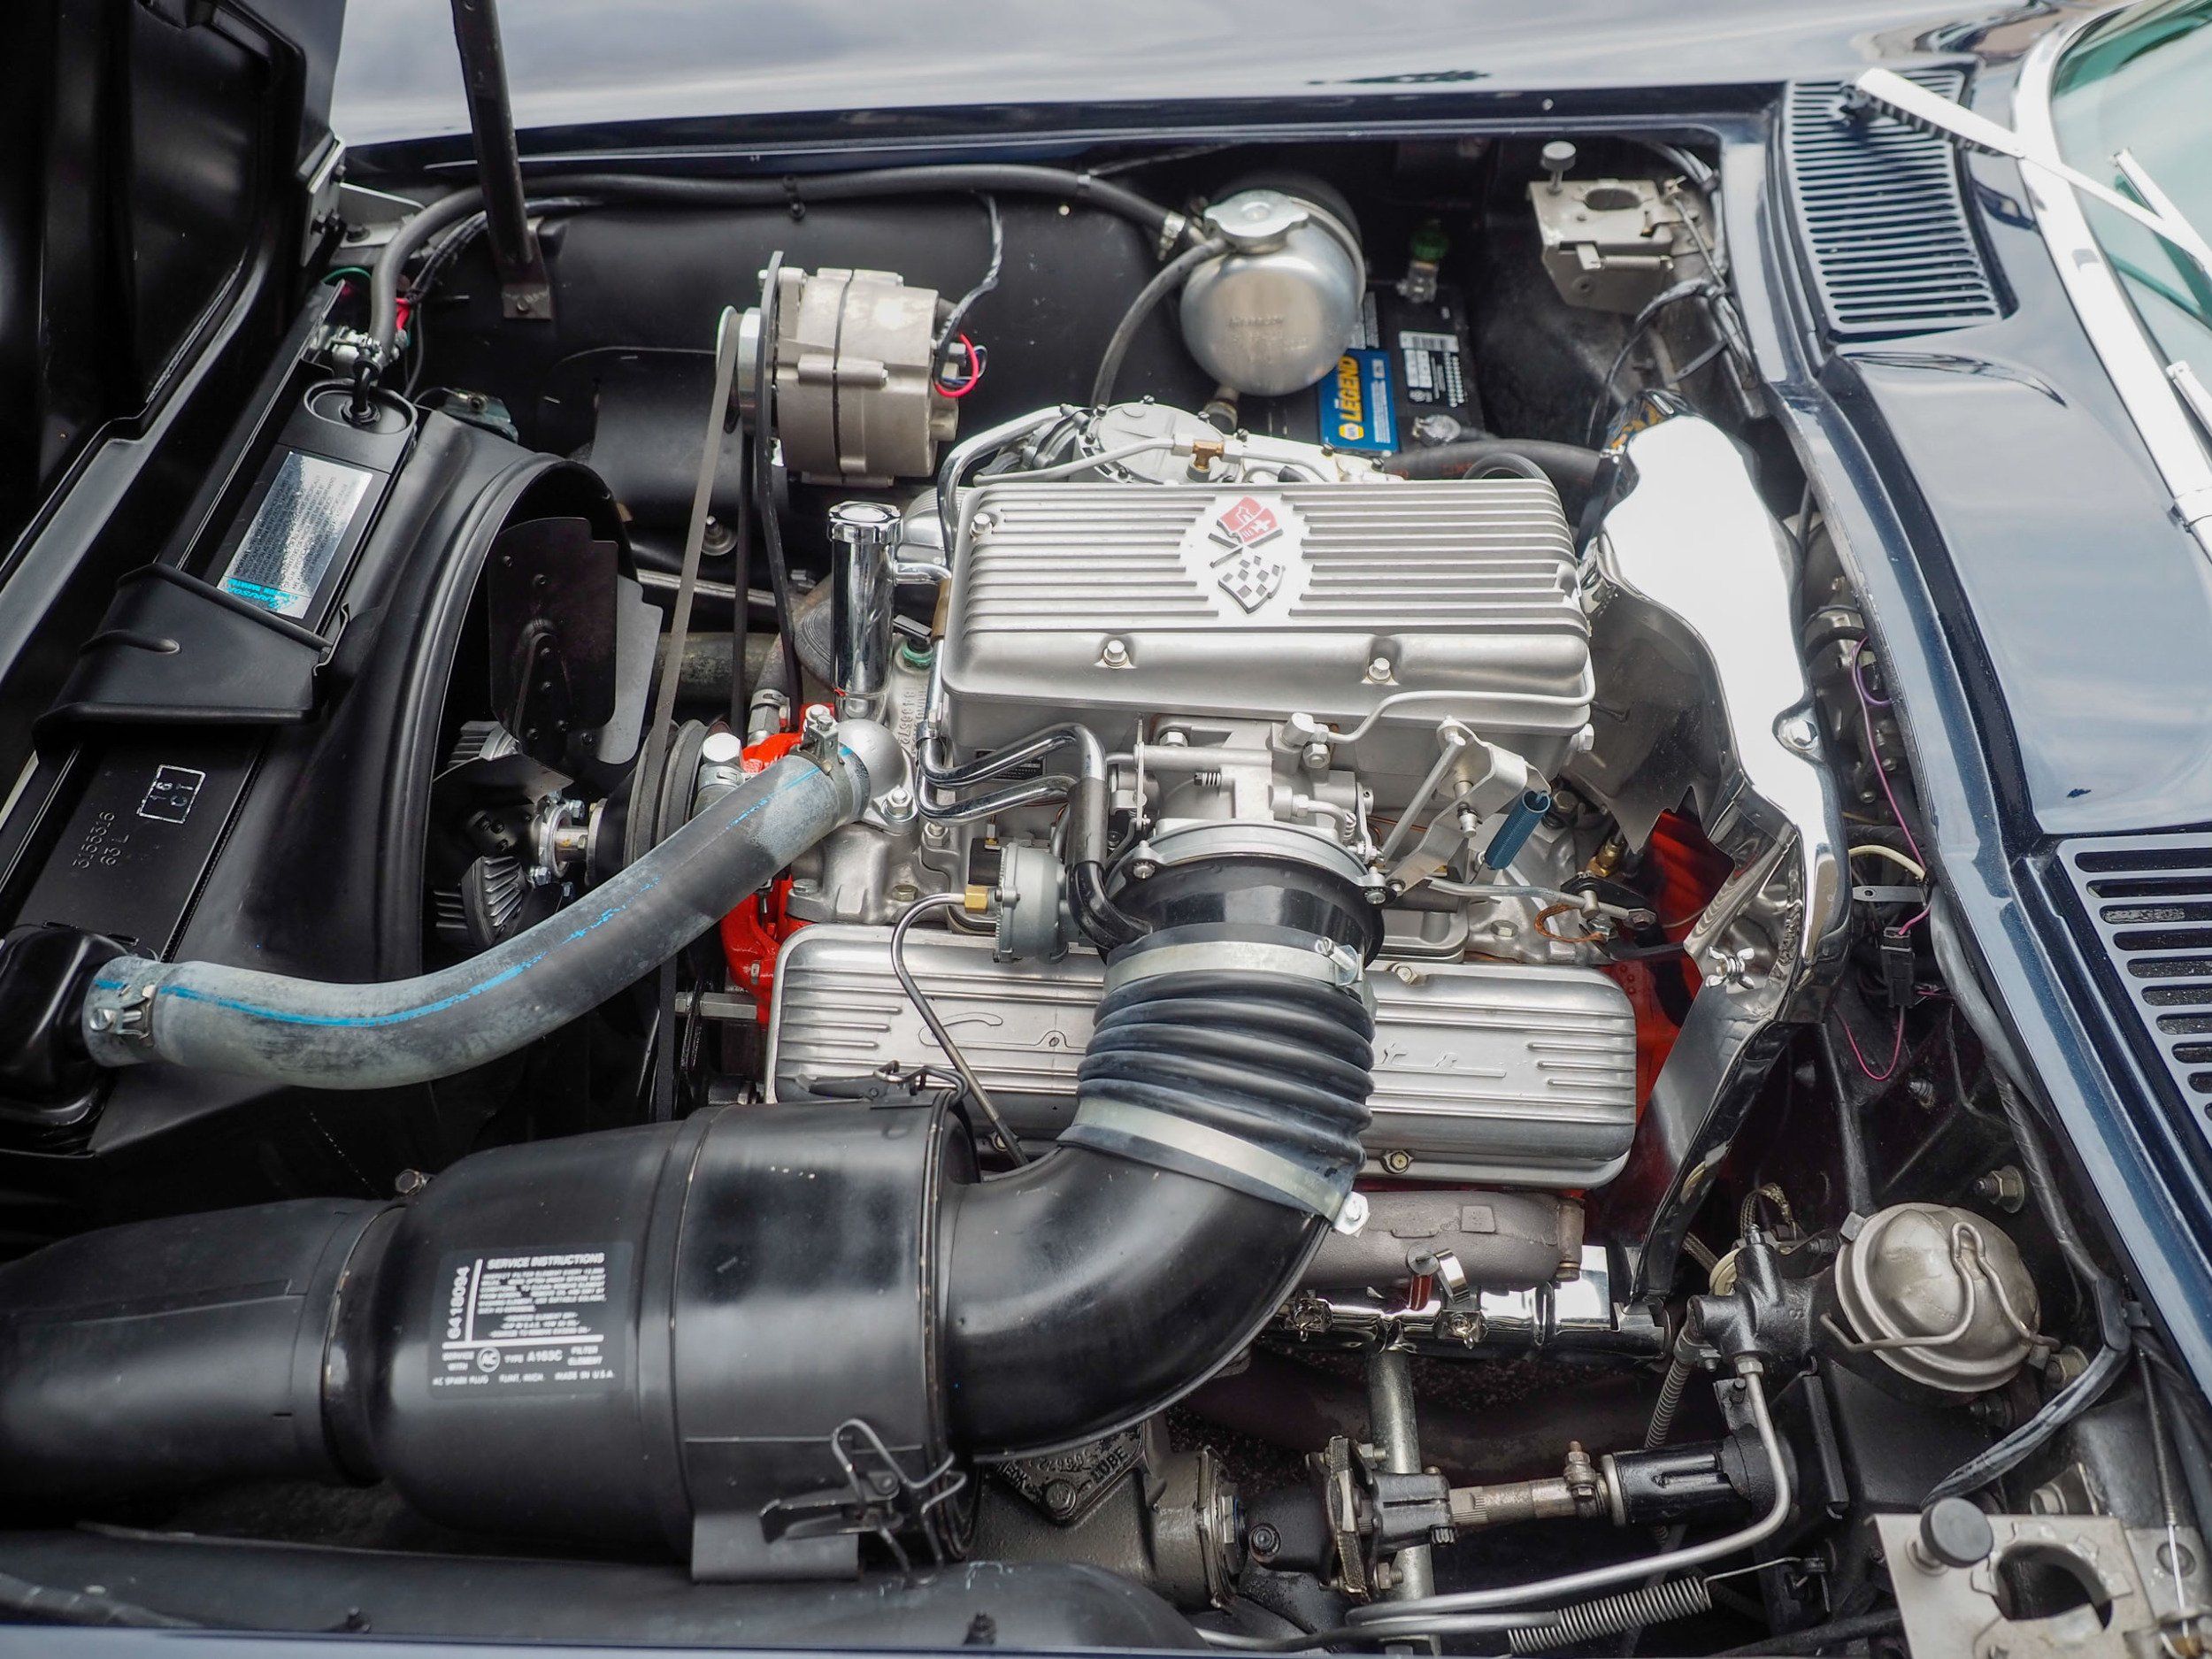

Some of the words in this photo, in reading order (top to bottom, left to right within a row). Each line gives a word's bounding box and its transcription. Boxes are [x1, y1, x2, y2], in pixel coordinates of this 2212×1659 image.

[1338, 354, 1363, 422] LEGEND
[487, 1256, 530, 1270] SERVICE
[531, 1252, 604, 1266] INSTRUCTIONS
